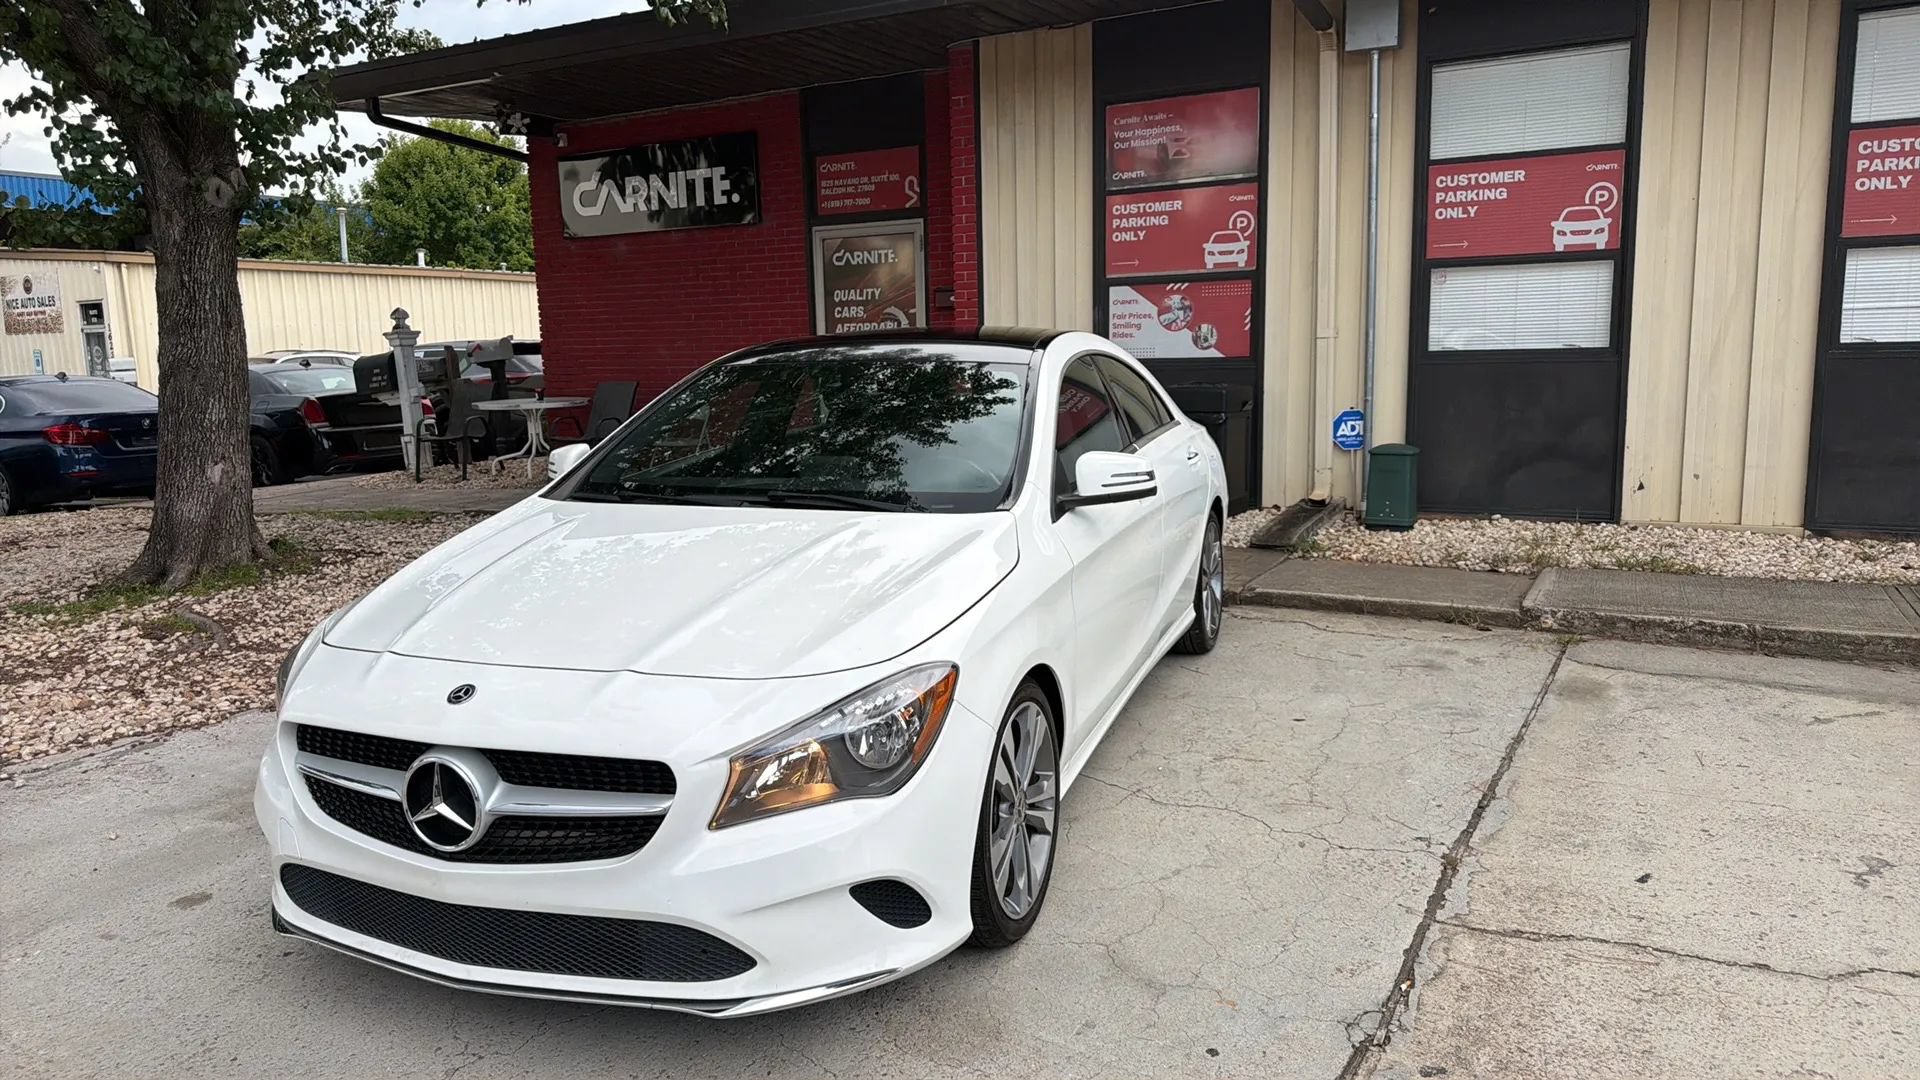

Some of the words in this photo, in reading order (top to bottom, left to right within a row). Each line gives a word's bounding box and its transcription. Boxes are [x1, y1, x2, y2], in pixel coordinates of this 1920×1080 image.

[1113, 130, 1134, 139] Your
[1135, 125, 1184, 137] Happiness,
[1113, 141, 1130, 149] Our
[1131, 135, 1166, 148] Mission!
[1435, 169, 1526, 188] CUSTOMER
[1855, 175, 1913, 191] ONLY
[1435, 187, 1508, 204] PARKING
[1112, 200, 1182, 215] CUSTOMER
[1434, 205, 1479, 220] ONLY
[1112, 215, 1169, 229] PARKING
[1112, 230, 1146, 242] ONLY
[21, 297, 36, 309] AUTO
[37, 296, 56, 308] SALES
[834, 288, 881, 303] QUALITY
[834, 306, 867, 319] CARS,
[1112, 312, 1127, 320] Fair
[1128, 311, 1154, 320] Prices,
[1112, 321, 1142, 331] Smiling
[1112, 331, 1136, 339] Rides.
[1336, 420, 1364, 437] ADT
